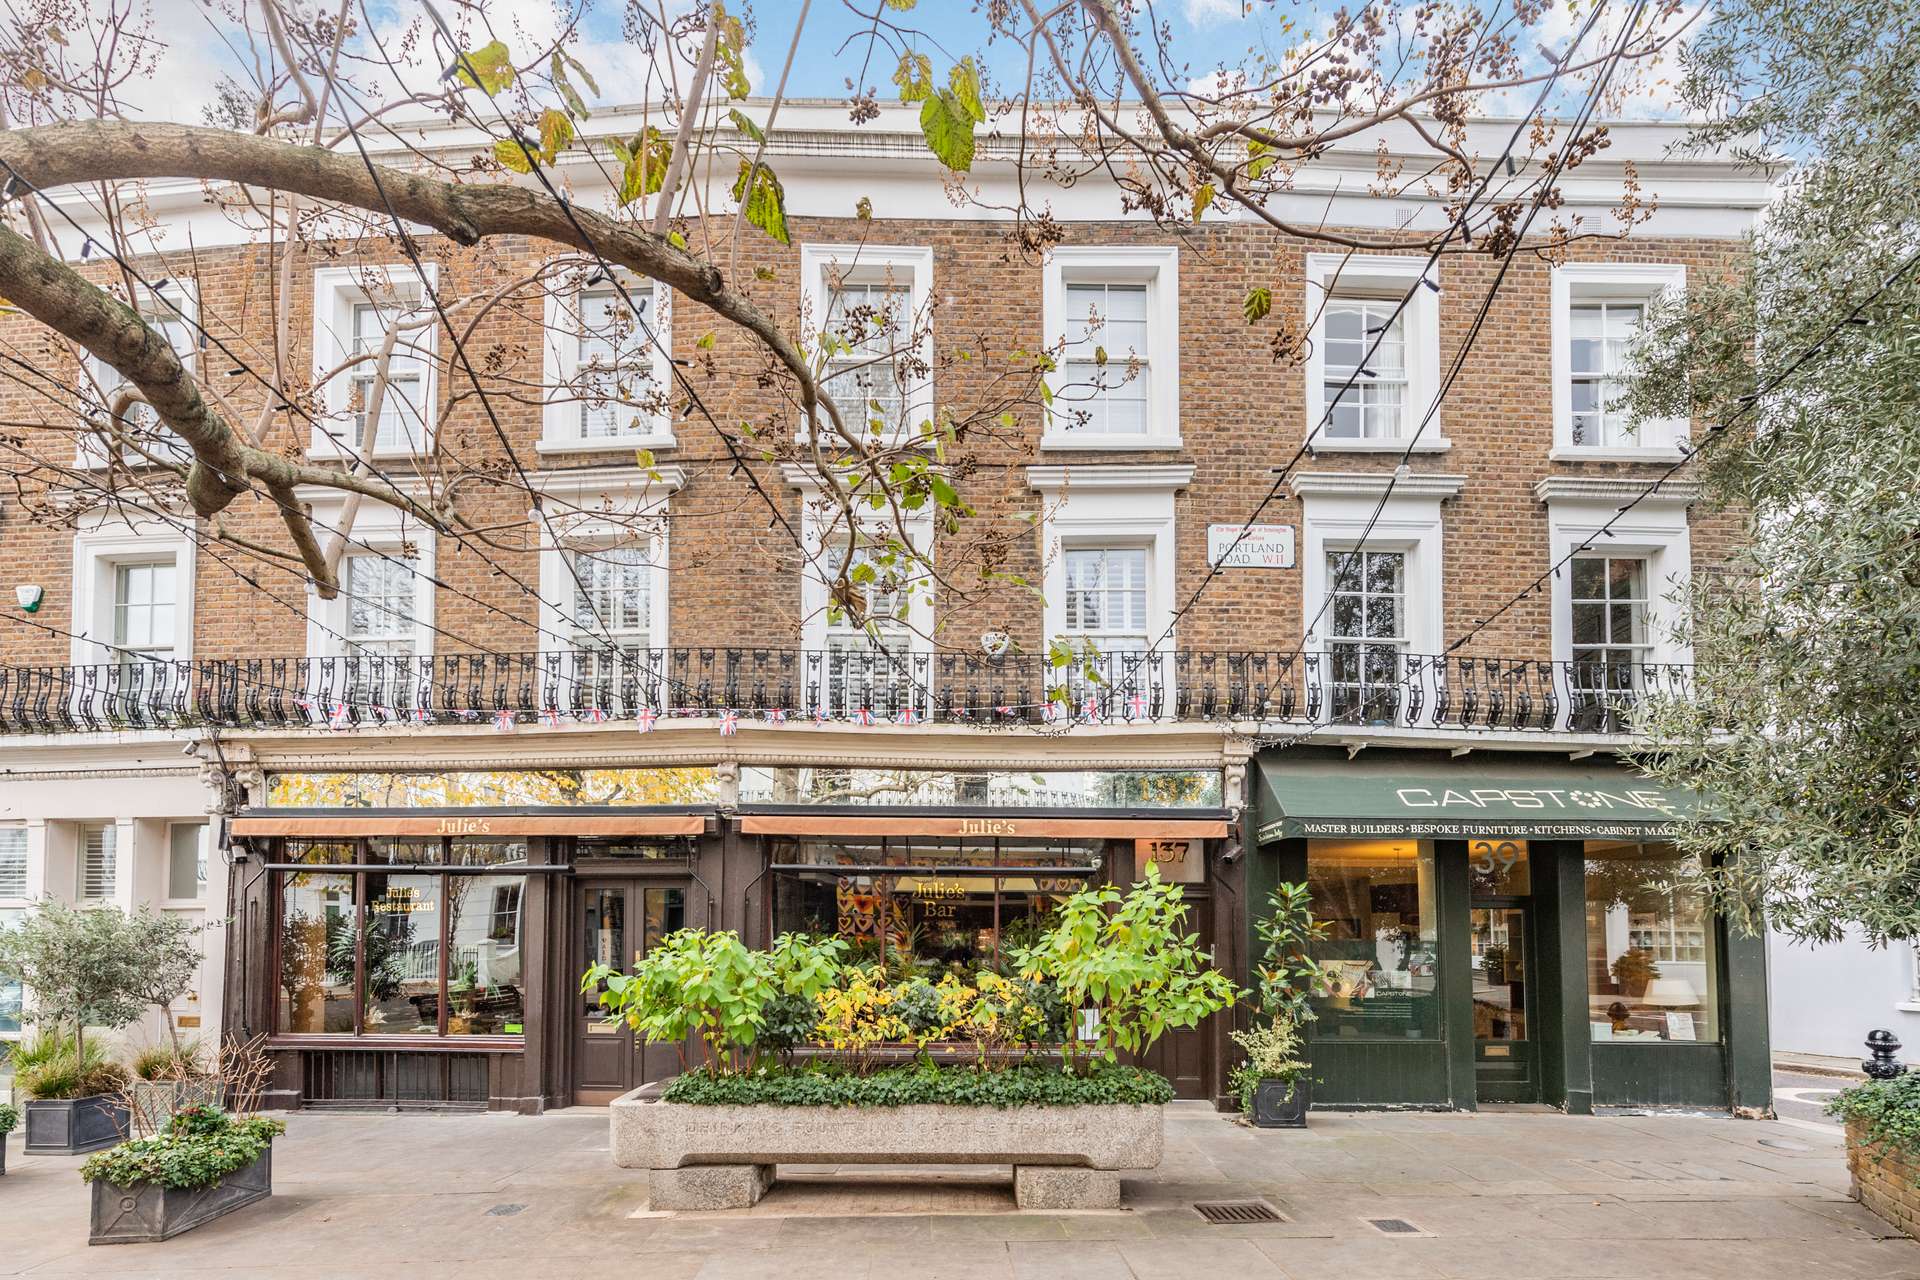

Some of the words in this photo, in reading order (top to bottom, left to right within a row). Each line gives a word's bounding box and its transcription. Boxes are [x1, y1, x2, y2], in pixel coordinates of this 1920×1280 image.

[1218, 543, 1284, 553] PORTLAND
[1396, 788, 1676, 809] CAPSTONE
[437, 818, 490, 833] Julie's
[958, 819, 1016, 834] Julie's
[1304, 824, 1348, 833] MASTER
[1350, 824, 1404, 834] BUILDERS
[1410, 825, 1460, 834] BESPOKE
[1462, 825, 1528, 835] FURNITURE
[1534, 825, 1591, 835] KITCHENS
[1596, 826, 1641, 835] CABINET
[1149, 842, 1189, 862] 137
[1475, 841, 1520, 874] 39
[912, 882, 965, 899] Julie's
[922, 900, 957, 917] Bar
